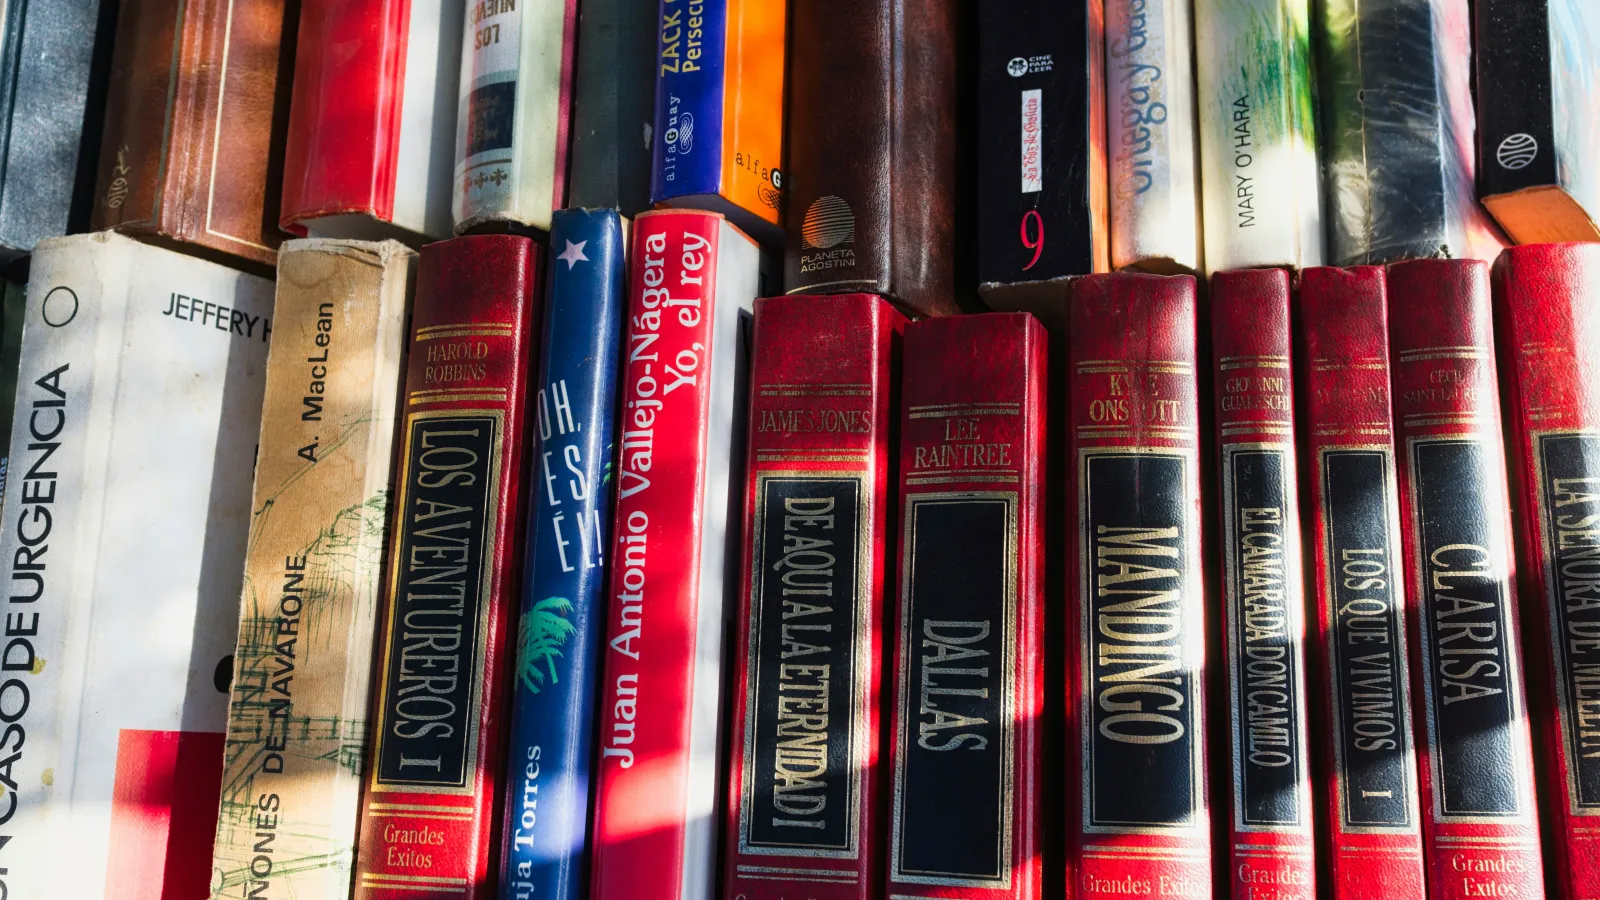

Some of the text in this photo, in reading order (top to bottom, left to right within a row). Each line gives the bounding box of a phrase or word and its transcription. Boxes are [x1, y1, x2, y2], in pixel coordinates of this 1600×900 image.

[473, 24, 500, 52] LOS
[660, 9, 682, 78] ZACK
[1029, 54, 1052, 62] CINE
[1029, 60, 1054, 68] PARA
[1023, 98, 1039, 133] Galicia
[664, 95, 681, 182] alfaGuay
[1022, 133, 1038, 144] de
[1022, 167, 1038, 182] La
[1233, 93, 1256, 229] MARY O'HARA
[800, 248, 856, 265] PLANETA
[1020, 210, 1045, 271] 9
[800, 258, 856, 273] AGOSTINI
[162, 292, 260, 338] JEFFERY
[663, 231, 712, 396] Yo, el rey
[427, 341, 489, 362] HAROLD
[297, 302, 334, 464] A. MacLean
[425, 363, 487, 383] ROBBINS
[1109, 374, 1159, 396] KYE
[1226, 376, 1284, 393] GIONNI
[1430, 369, 1465, 384] CECIL
[1089, 399, 1181, 422] ONSTT
[1221, 394, 1290, 411] GUASCHI
[1403, 386, 1479, 403] SAINT-LAURE
[758, 409, 872, 433] JAMES JONES
[944, 417, 981, 441] LEE
[914, 443, 1013, 469] RAINTREE
[10, 362, 70, 604] URGENCIA
[542, 445, 588, 507] ES
[1553, 477, 1600, 508] LA
[603, 231, 670, 769] Juan Antonio Vallejo-Nágera
[783, 495, 835, 531] DE
[552, 509, 604, 573] ÉL!
[773, 533, 836, 597] AQUI
[393, 428, 480, 773] LOS AVENTUREROS I
[781, 599, 834, 620] A
[269, 555, 307, 720] NAVARONE
[1096, 523, 1185, 746] MANDINGO
[1241, 506, 1292, 768] EL CAMARADA DON CAMILO
[1430, 543, 1503, 706] CLARISA
[1568, 620, 1600, 655] DE
[2, 612, 40, 672] DE
[780, 623, 833, 660] LA
[917, 618, 991, 753] DALLAS
[1338, 548, 1397, 799] LOS QUE VIVIMOS I
[262, 734, 287, 774] DE
[773, 662, 832, 815] ETERNIDAD
[514, 745, 542, 852] Torres
[384, 823, 445, 846] Grandes
[772, 817, 827, 830] I
[386, 847, 433, 869] Exitos
[1238, 863, 1310, 885] Grandes
[1452, 853, 1525, 873] Grandes
[1082, 873, 1151, 894] Grandes
[1463, 877, 1519, 897] Exitos
